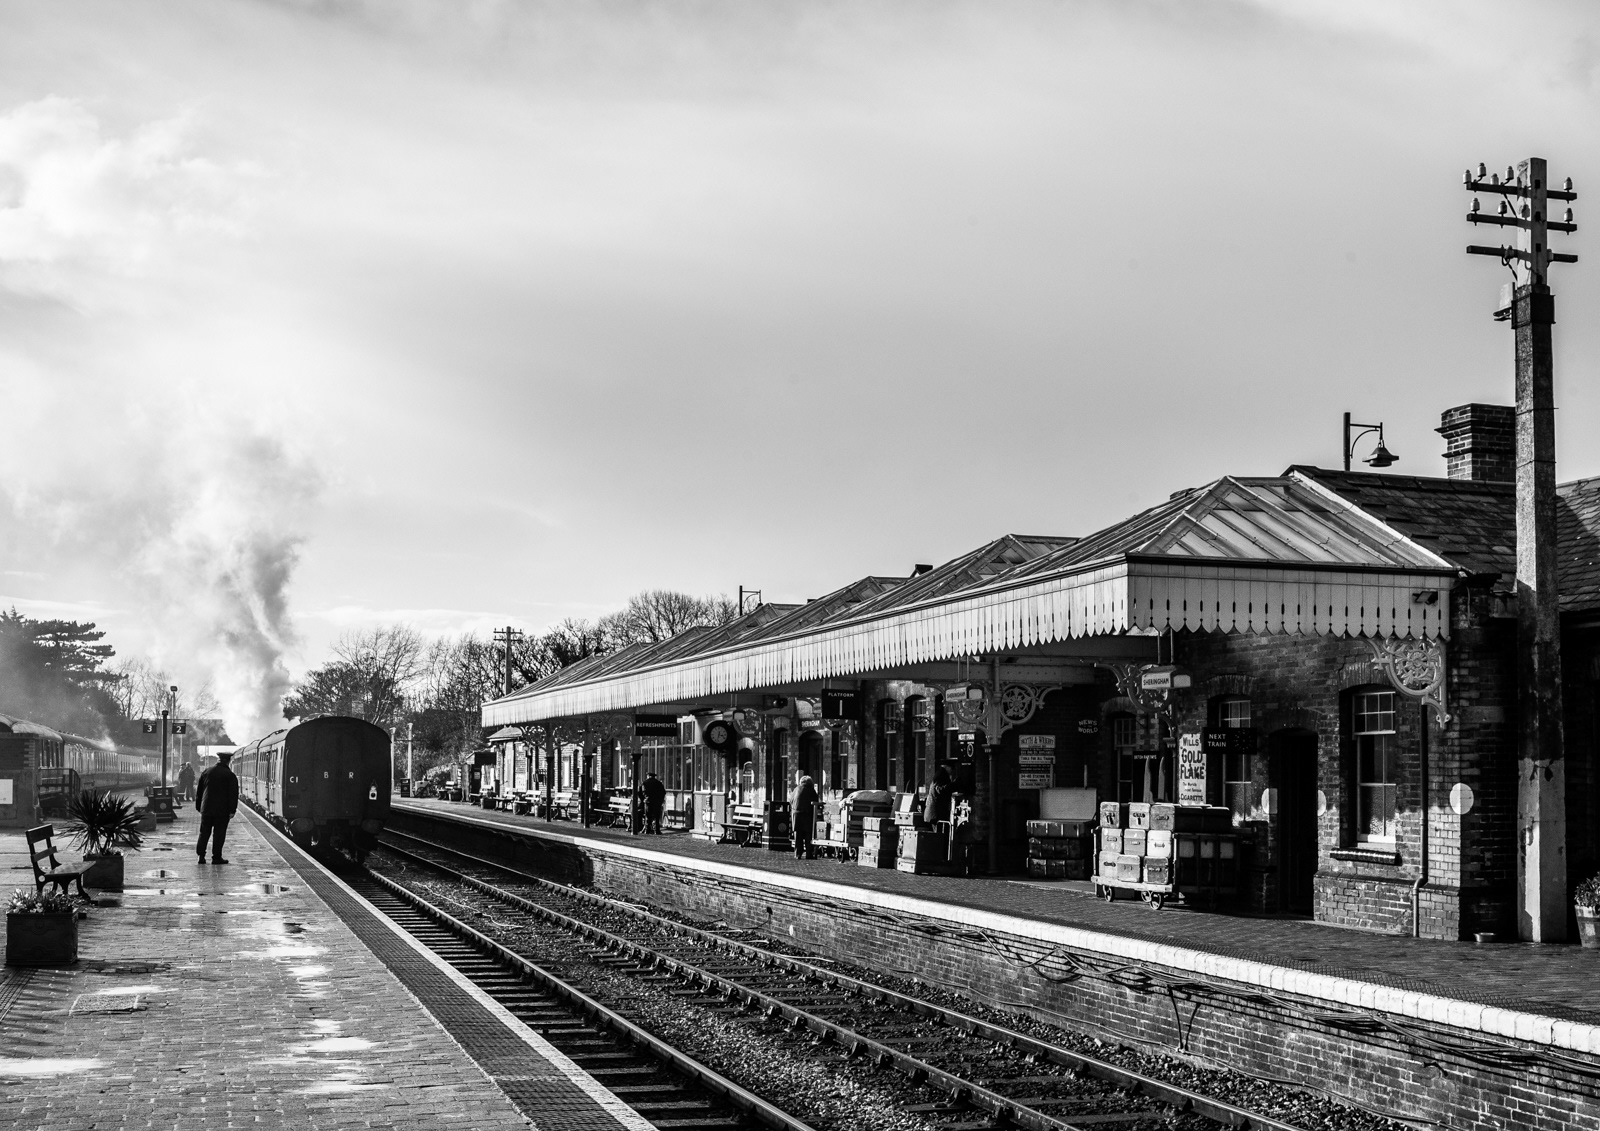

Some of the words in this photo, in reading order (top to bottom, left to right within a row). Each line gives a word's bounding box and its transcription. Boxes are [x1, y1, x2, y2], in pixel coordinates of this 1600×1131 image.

[1143, 678, 1170, 686] SHERINGHAM
[147, 724, 153, 733] 3
[176, 725, 182, 733] 2
[1078, 726, 1099, 734] WORLD
[323, 771, 329, 779] B
[348, 771, 354, 779] R
